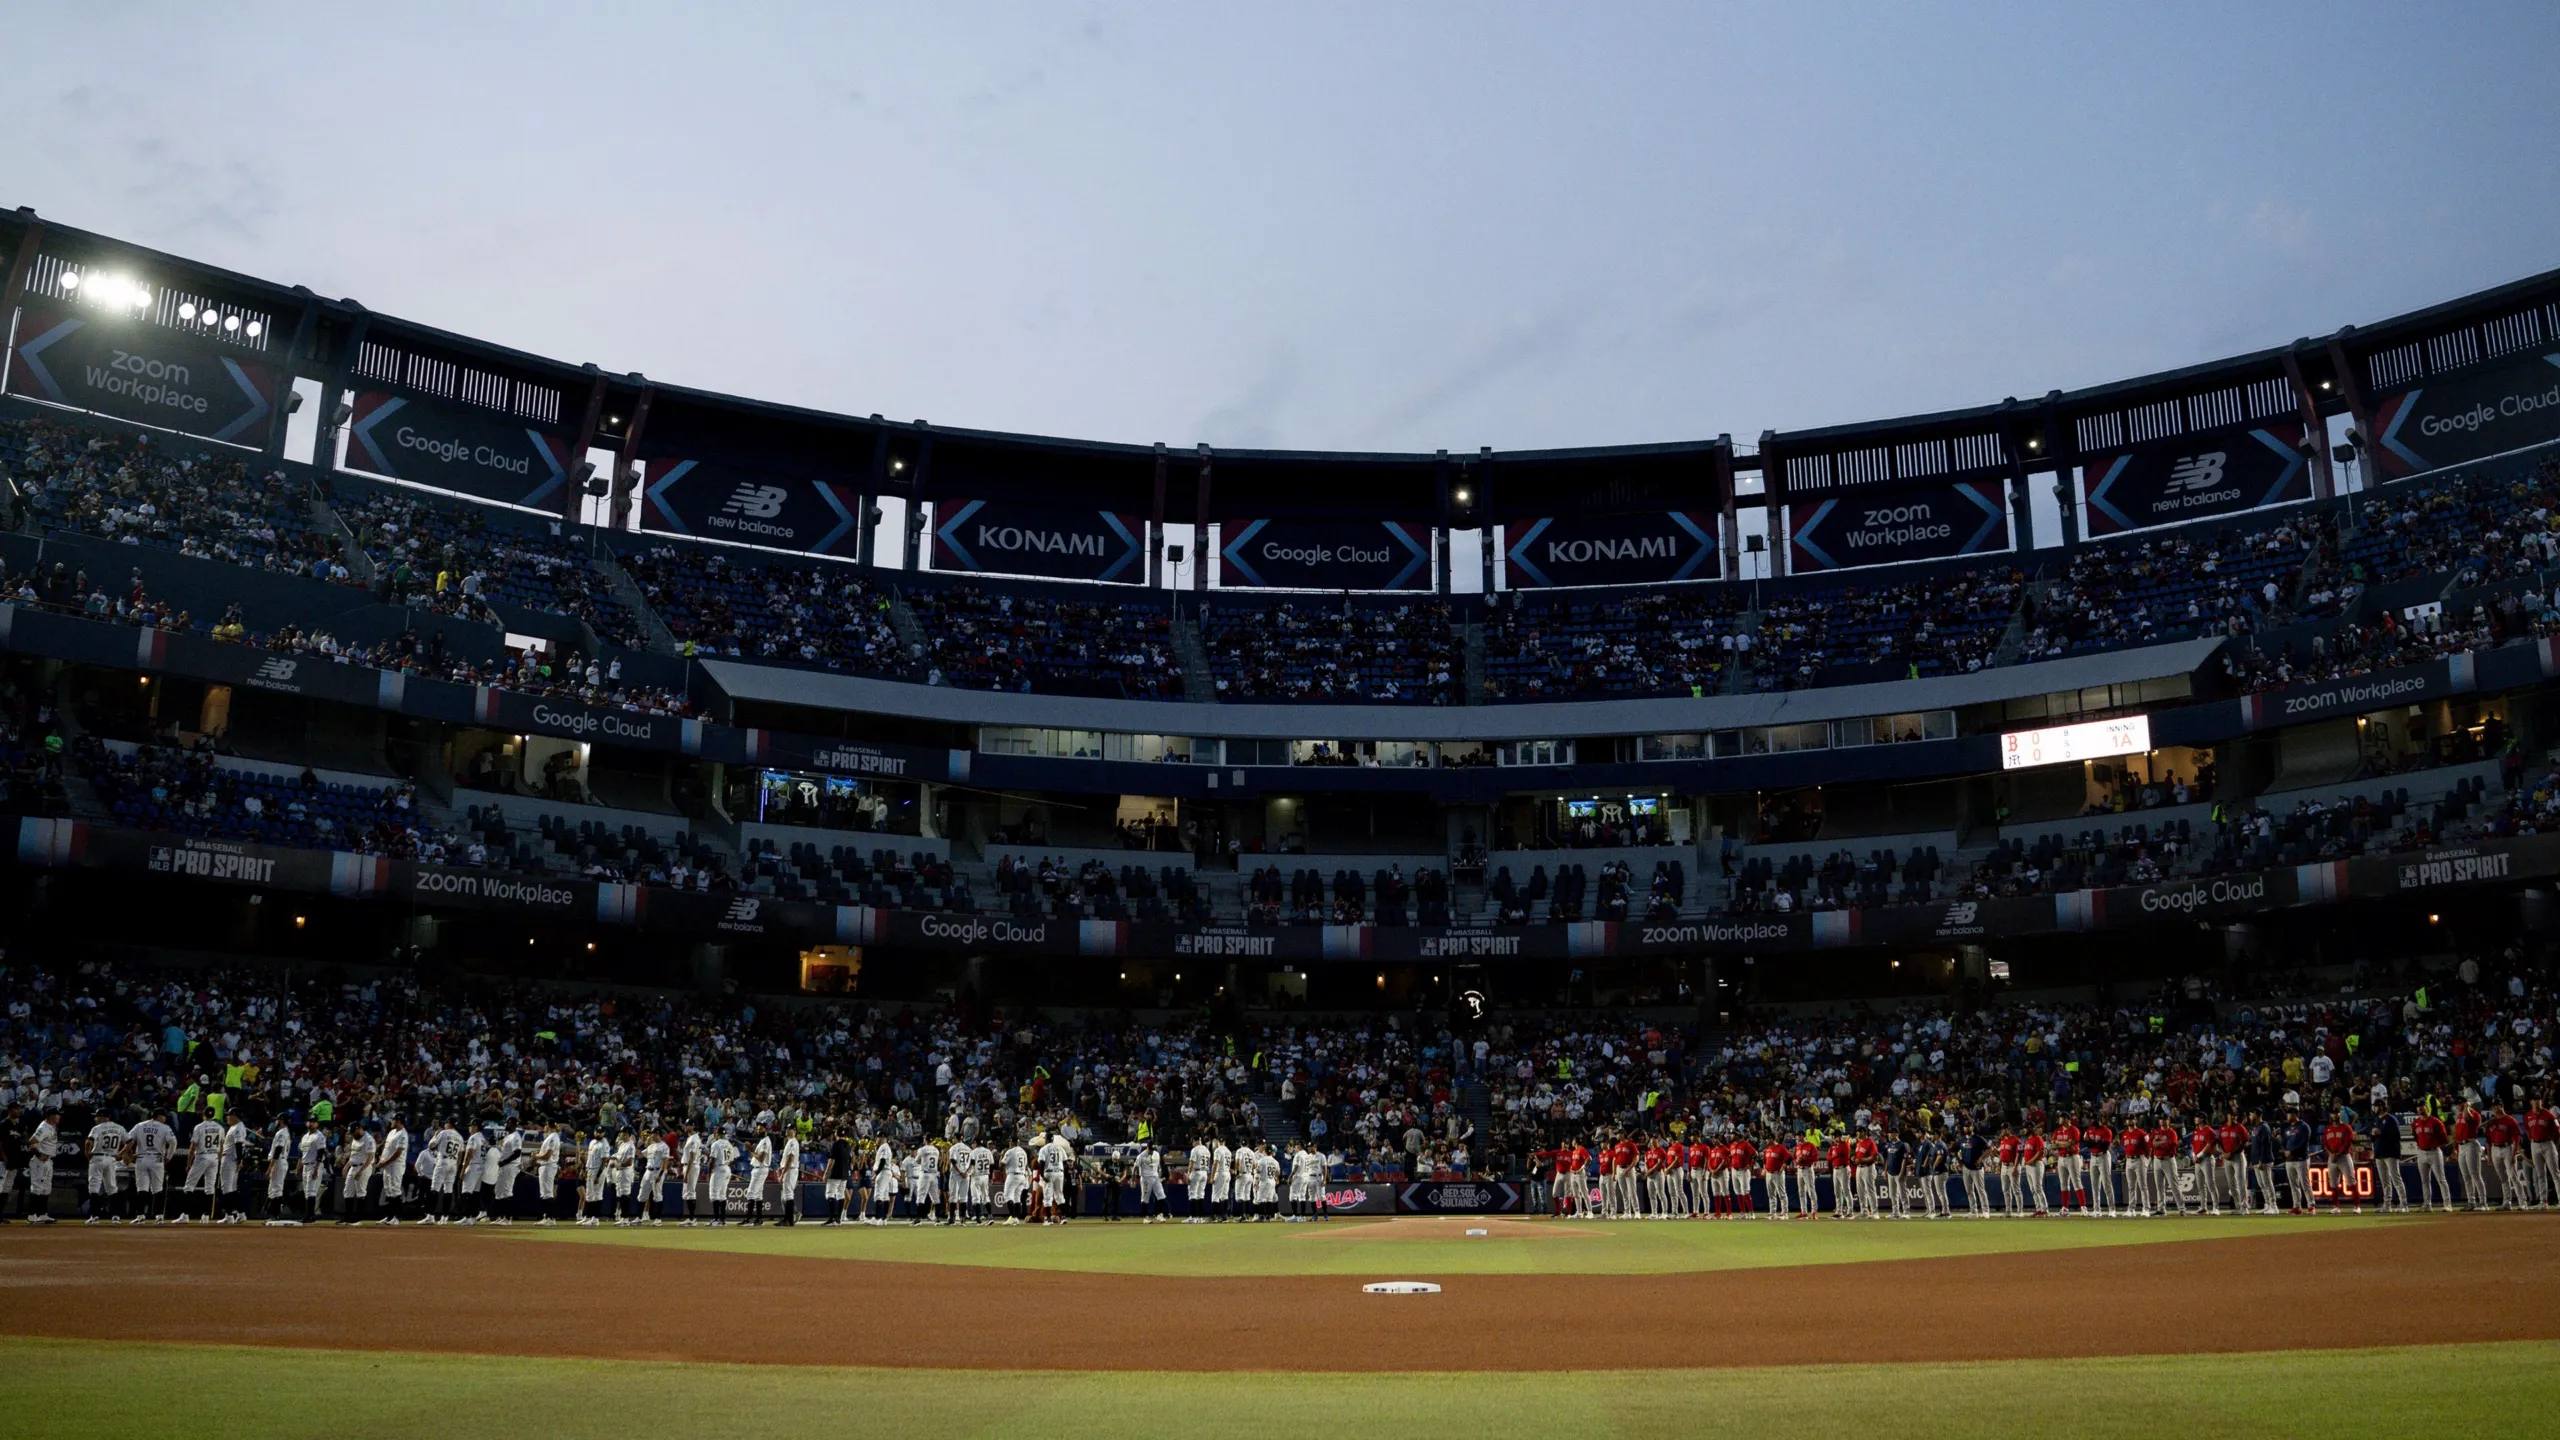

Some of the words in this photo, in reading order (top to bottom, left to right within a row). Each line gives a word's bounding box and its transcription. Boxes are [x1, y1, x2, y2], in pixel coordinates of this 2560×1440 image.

[111, 350, 189, 386] zoom
[86, 365, 208, 413] Workplace
[2421, 402, 2495, 436] Google
[2500, 384, 2560, 416] Cloud
[397, 427, 469, 462] Google
[475, 446, 529, 474] Cloud
[2152, 500, 2180, 513] new
[2183, 488, 2241, 507] balance
[1864, 504, 1931, 527] zoom
[708, 515, 735, 529] new
[738, 518, 794, 538] balance
[1846, 524, 1951, 548] Workplace
[979, 525, 1105, 557] KONAMI
[1549, 536, 1677, 562] KONAMI
[1263, 542, 1332, 566] Google
[1337, 545, 1390, 562] Cloud
[247, 678, 264, 686] new
[265, 680, 300, 692] balance
[2285, 691, 2337, 714] zoom
[2340, 676, 2425, 704] Workplace
[533, 704, 598, 734] Google
[603, 715, 651, 739] Cloud
[2106, 722, 2135, 733] INNING
[2007, 735, 2018, 752] B
[2032, 732, 2040, 745] 0
[2112, 733, 2133, 748] 1A
[831, 752, 858, 770] PRO
[861, 754, 906, 775] SPIRIT
[2033, 749, 2041, 762] 0
[194, 841, 244, 854] eBASEBALL
[2434, 847, 2479, 860] eBASEBALL
[148, 860, 170, 872] MLB
[173, 849, 211, 876] PRO
[213, 853, 275, 882] SPIRIT
[2420, 860, 2453, 886] PRO
[2454, 852, 2510, 882] SPIRIT
[416, 871, 477, 895] zoom
[482, 877, 573, 905] Workplace
[2400, 877, 2418, 889] MLB
[2141, 884, 2208, 913] Google
[2212, 876, 2264, 903] Cloud
[717, 921, 733, 930] new
[733, 921, 764, 933] balance
[921, 915, 988, 944] Google
[992, 921, 1045, 942] Cloud
[1642, 926, 1697, 944] zoom
[1702, 922, 1788, 943] Workplace
[1935, 928, 1952, 936] new
[1952, 925, 1985, 936] balance
[1194, 935, 1223, 954] PRO
[1225, 936, 1275, 955] SPIRIT
[1439, 937, 1468, 956] PRO
[1470, 936, 1520, 956] SPIRIT
[102, 1135, 119, 1149] 30
[146, 1134, 155, 1147] 8
[204, 1134, 220, 1149] 84
[929, 1157, 936, 1169] 3
[977, 1159, 990, 1171] 32
[1050, 1152, 1061, 1164] 31
[1440, 1198, 1479, 1208] SULTANES
[1442, 1188, 1459, 1198] RED
[1459, 1188, 1476, 1198] SOX
